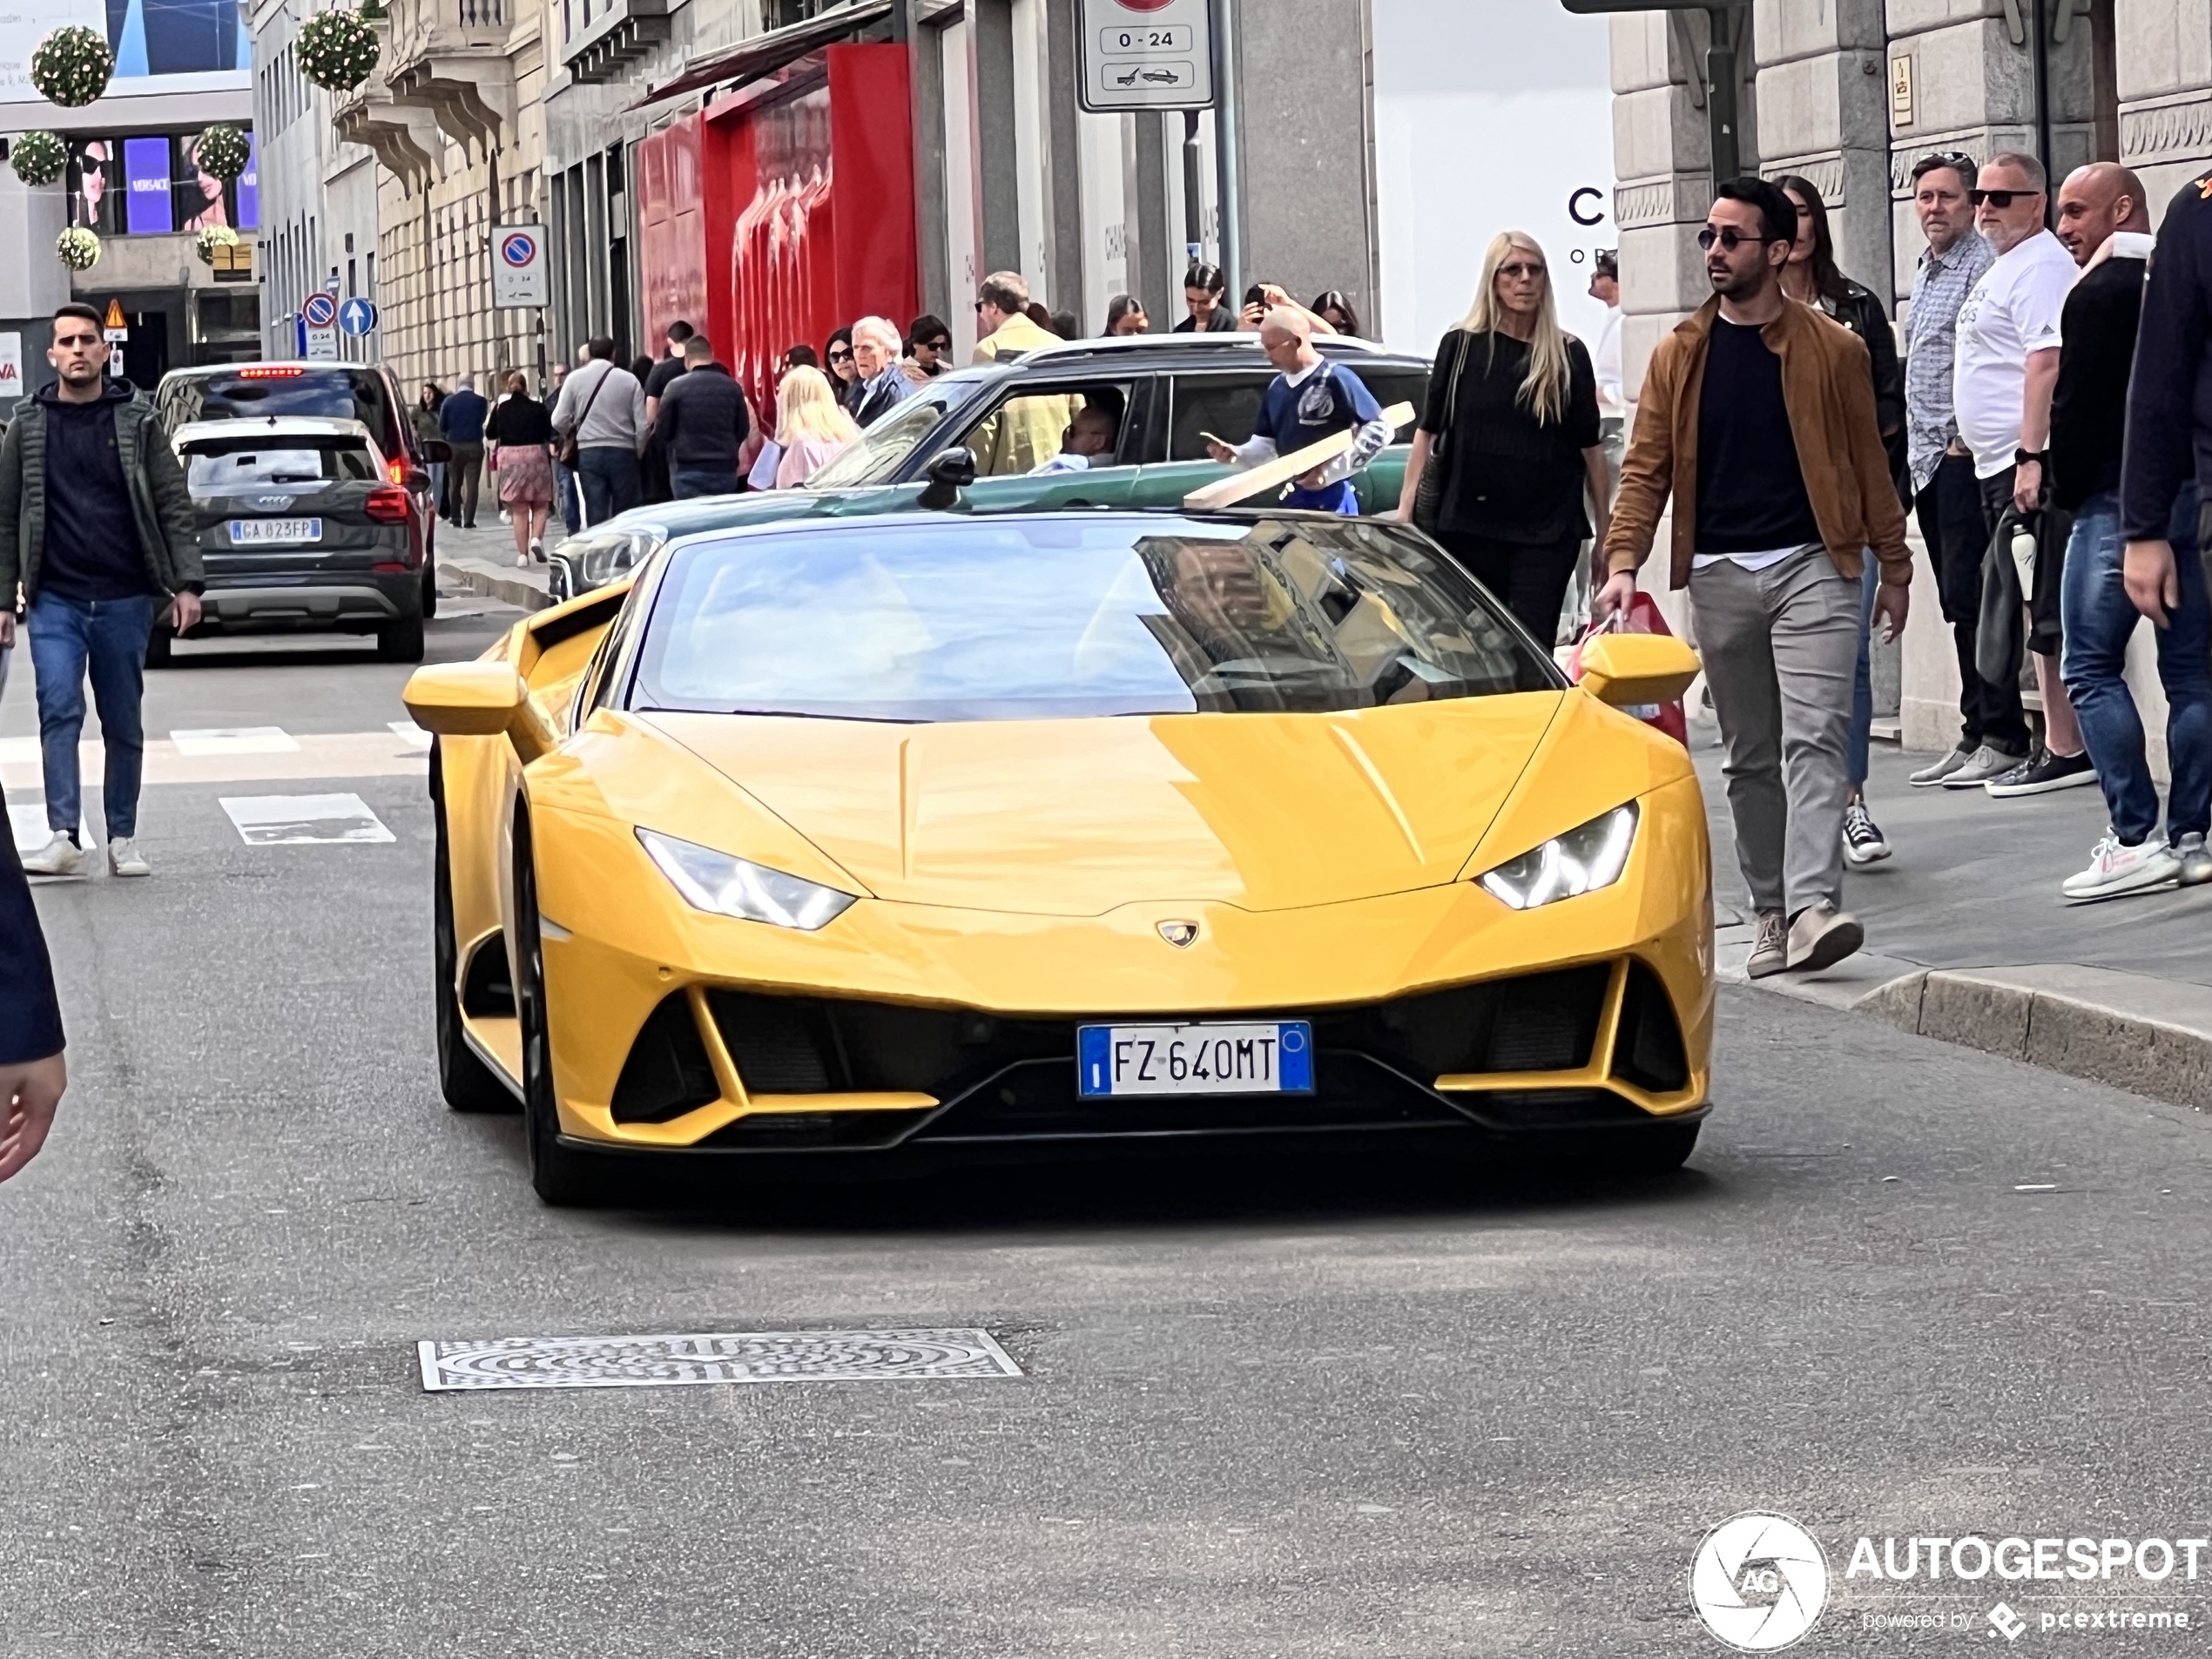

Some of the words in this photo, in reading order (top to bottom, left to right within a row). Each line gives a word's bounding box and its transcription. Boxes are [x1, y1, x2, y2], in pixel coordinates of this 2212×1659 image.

[1119, 33, 1131, 48] 0
[1149, 32, 1173, 46] 24
[1115, 1041, 1157, 1082] FZ
[1169, 1039, 1277, 1081] 640MT
